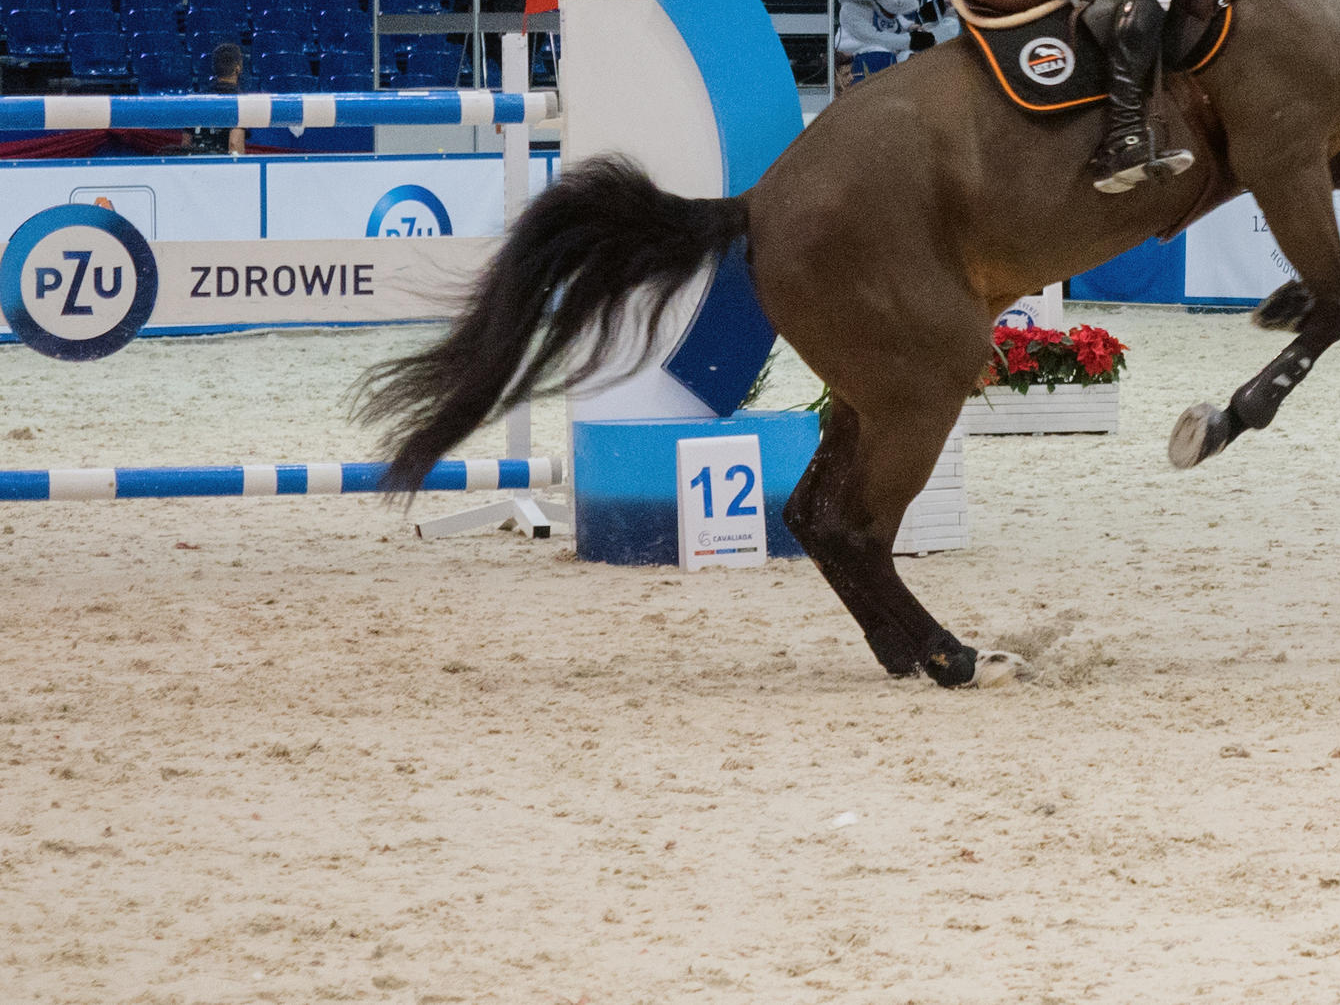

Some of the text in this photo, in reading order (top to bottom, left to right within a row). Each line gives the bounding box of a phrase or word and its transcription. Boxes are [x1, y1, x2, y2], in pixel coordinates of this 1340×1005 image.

[35, 250, 375, 316] PZU ZDROWIE
[1269, 248, 1298, 279] HODO
[690, 464, 757, 518] 12
